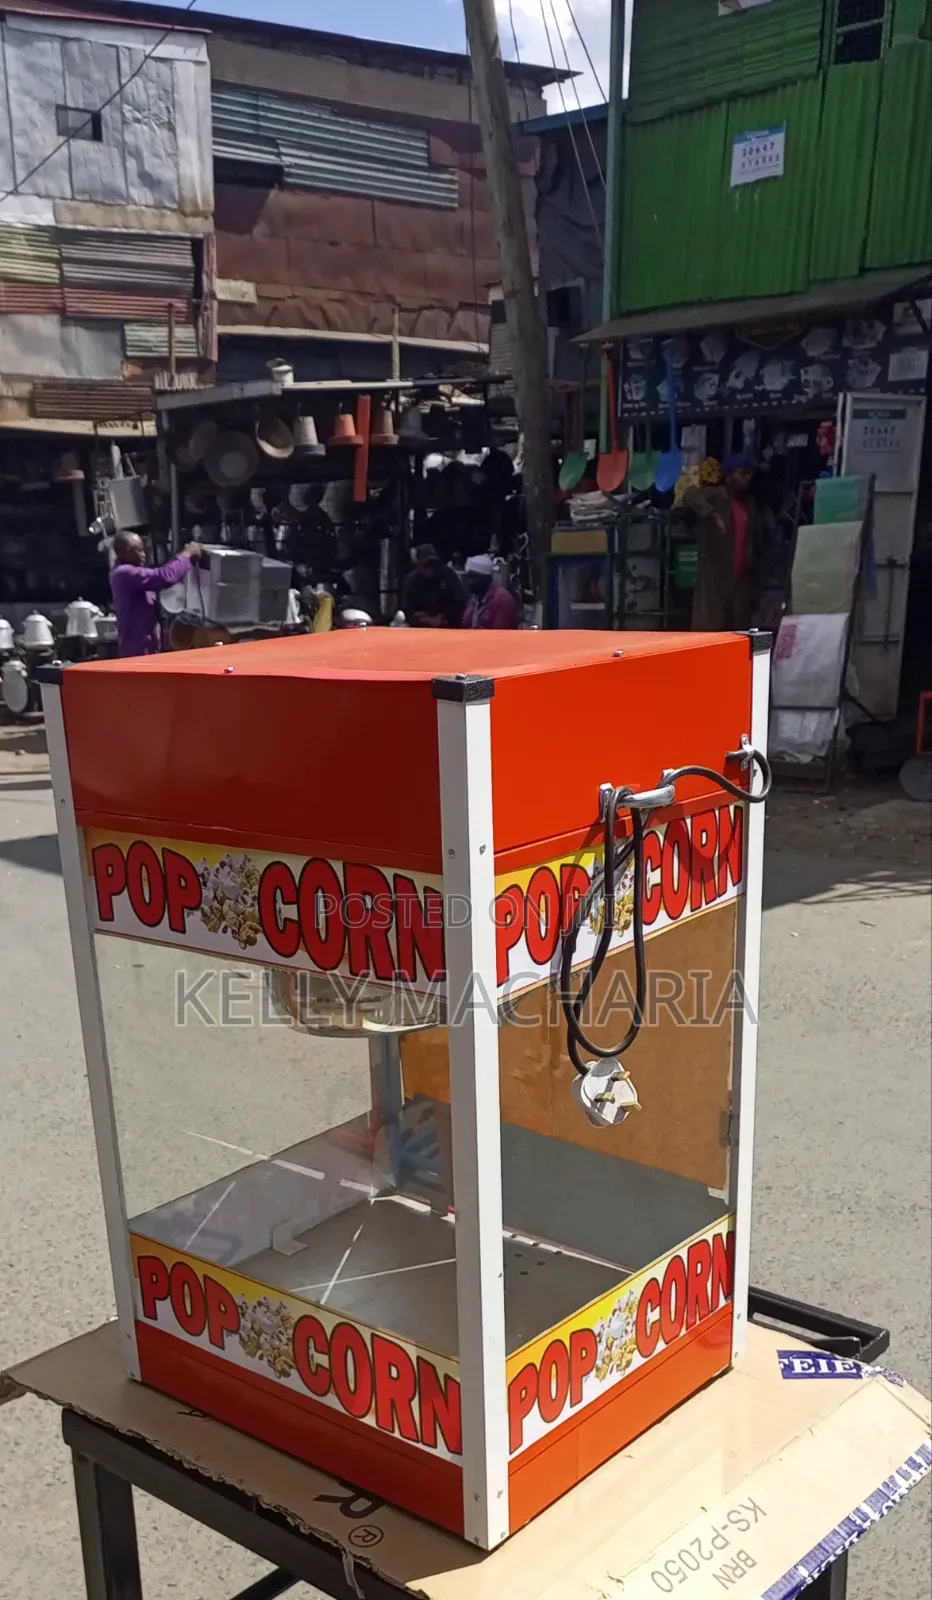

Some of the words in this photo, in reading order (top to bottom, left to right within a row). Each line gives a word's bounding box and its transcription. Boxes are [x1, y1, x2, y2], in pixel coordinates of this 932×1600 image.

[92, 840, 202, 934] POP
[258, 857, 446, 982] CORN
[496, 863, 591, 988] POP
[642, 805, 743, 925] CORN
[137, 1255, 240, 1350] POP
[293, 1314, 462, 1454] CORN
[508, 1328, 597, 1455] POP
[635, 1231, 734, 1358] CORN
[650, 1496, 767, 1594] KS-P2050
[711, 1548, 758, 1591] BRN
